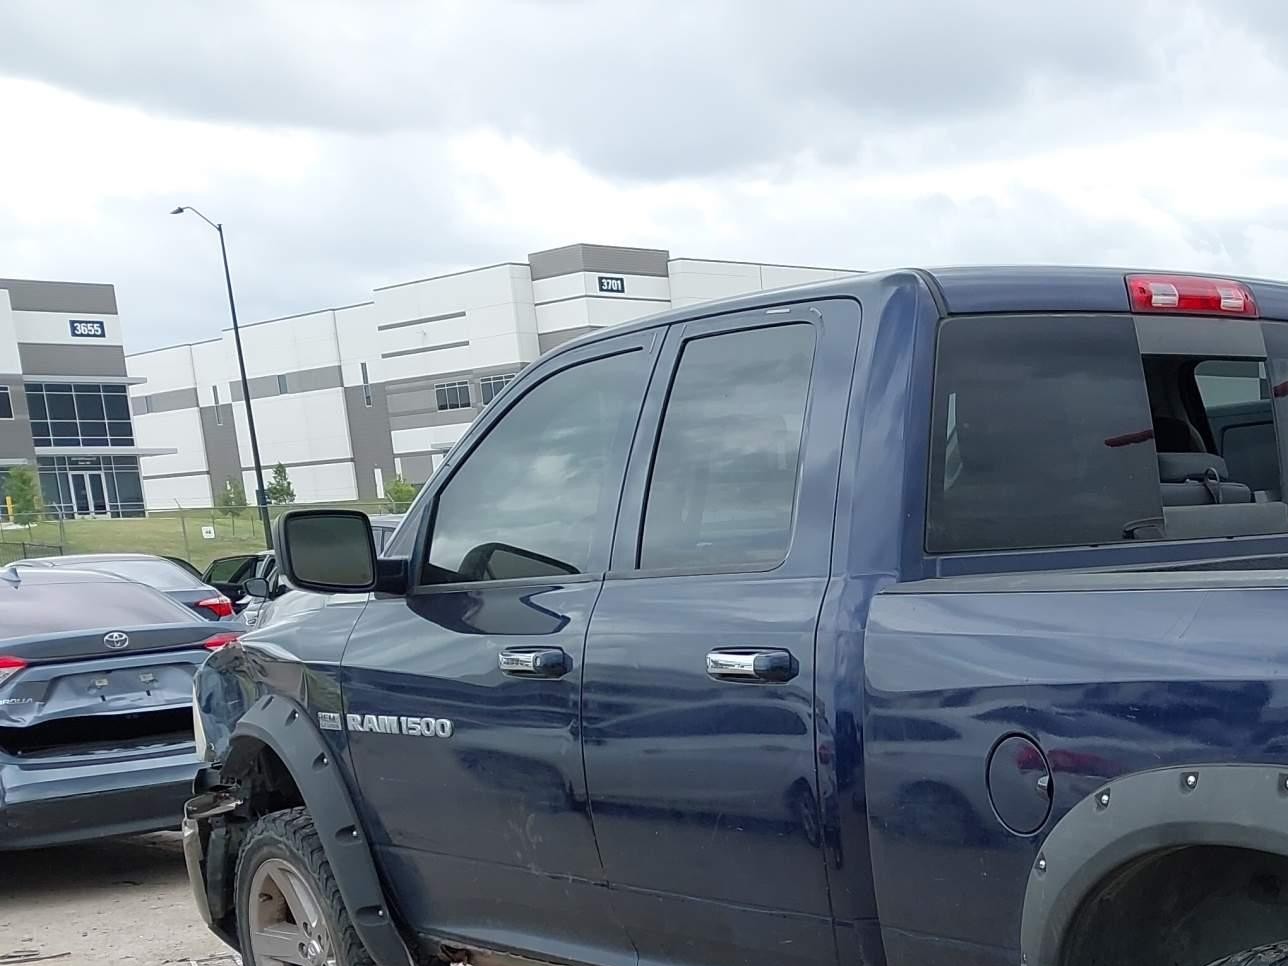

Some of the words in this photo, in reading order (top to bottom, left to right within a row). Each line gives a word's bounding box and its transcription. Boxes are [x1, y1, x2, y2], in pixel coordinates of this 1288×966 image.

[601, 279, 622, 291] 3701
[73, 322, 102, 336] 3655
[346, 713, 400, 735] RAM
[401, 716, 455, 739] 1500
